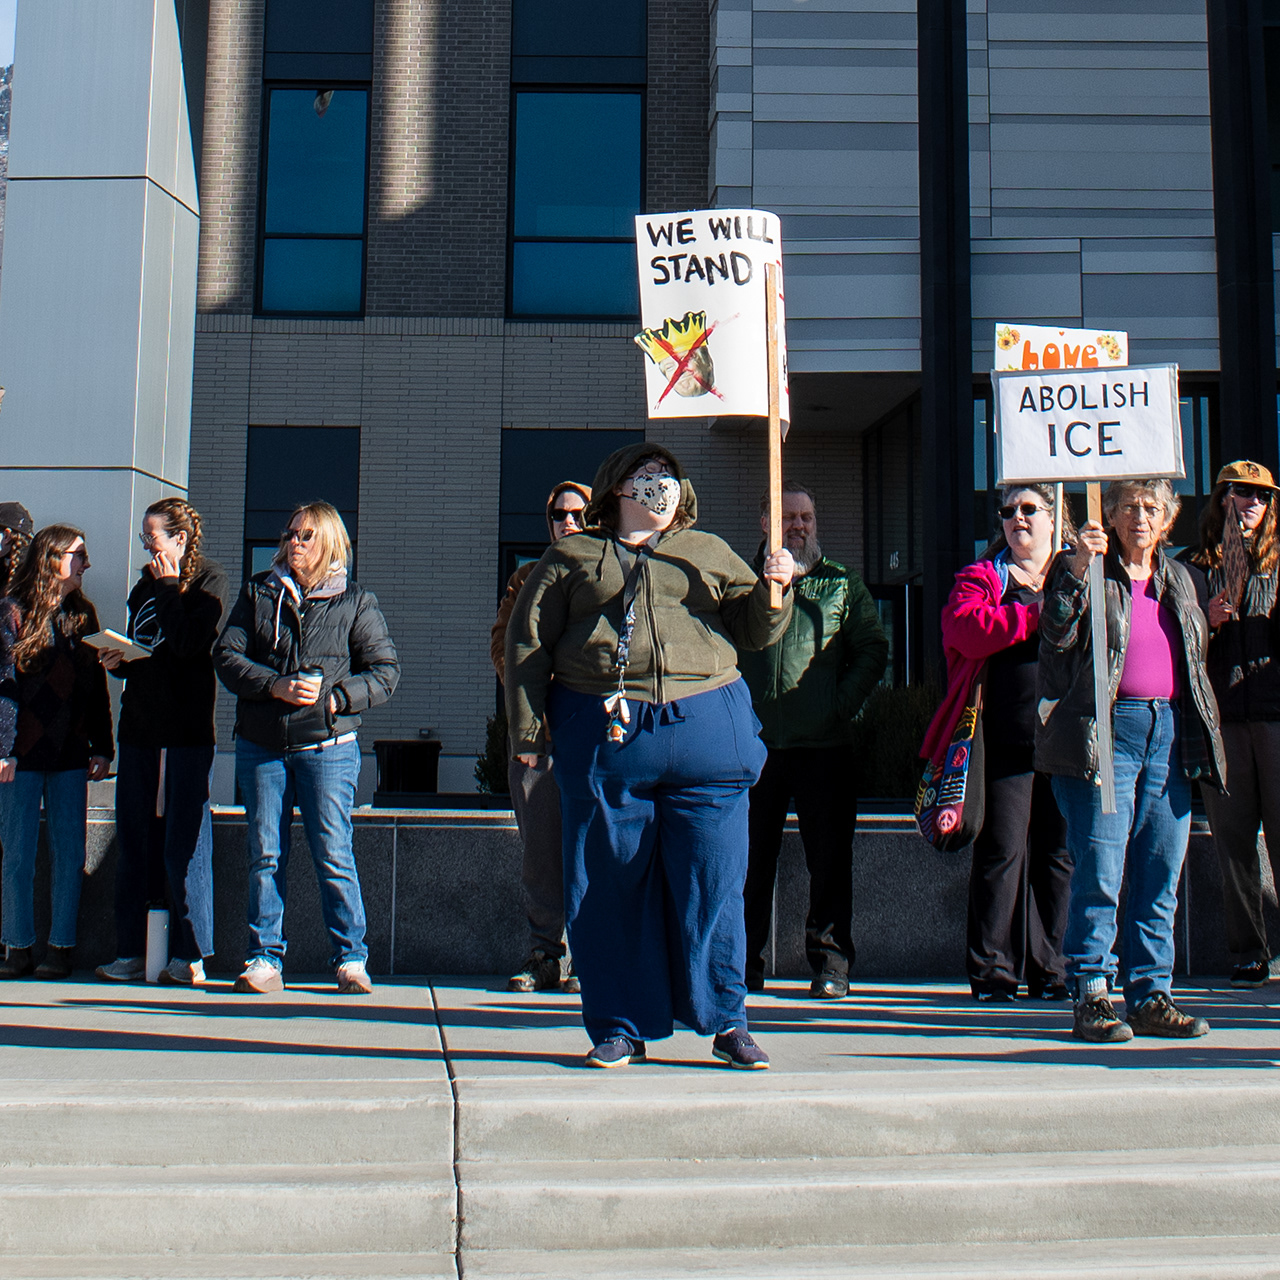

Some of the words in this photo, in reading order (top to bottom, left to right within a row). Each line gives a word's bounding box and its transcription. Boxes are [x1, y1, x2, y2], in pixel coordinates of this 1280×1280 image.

[646, 218, 696, 247] WE
[708, 215, 773, 244] WILL
[650, 251, 753, 286] STAND
[1019, 381, 1148, 413] ABOLISH
[1047, 421, 1123, 457] ICE
